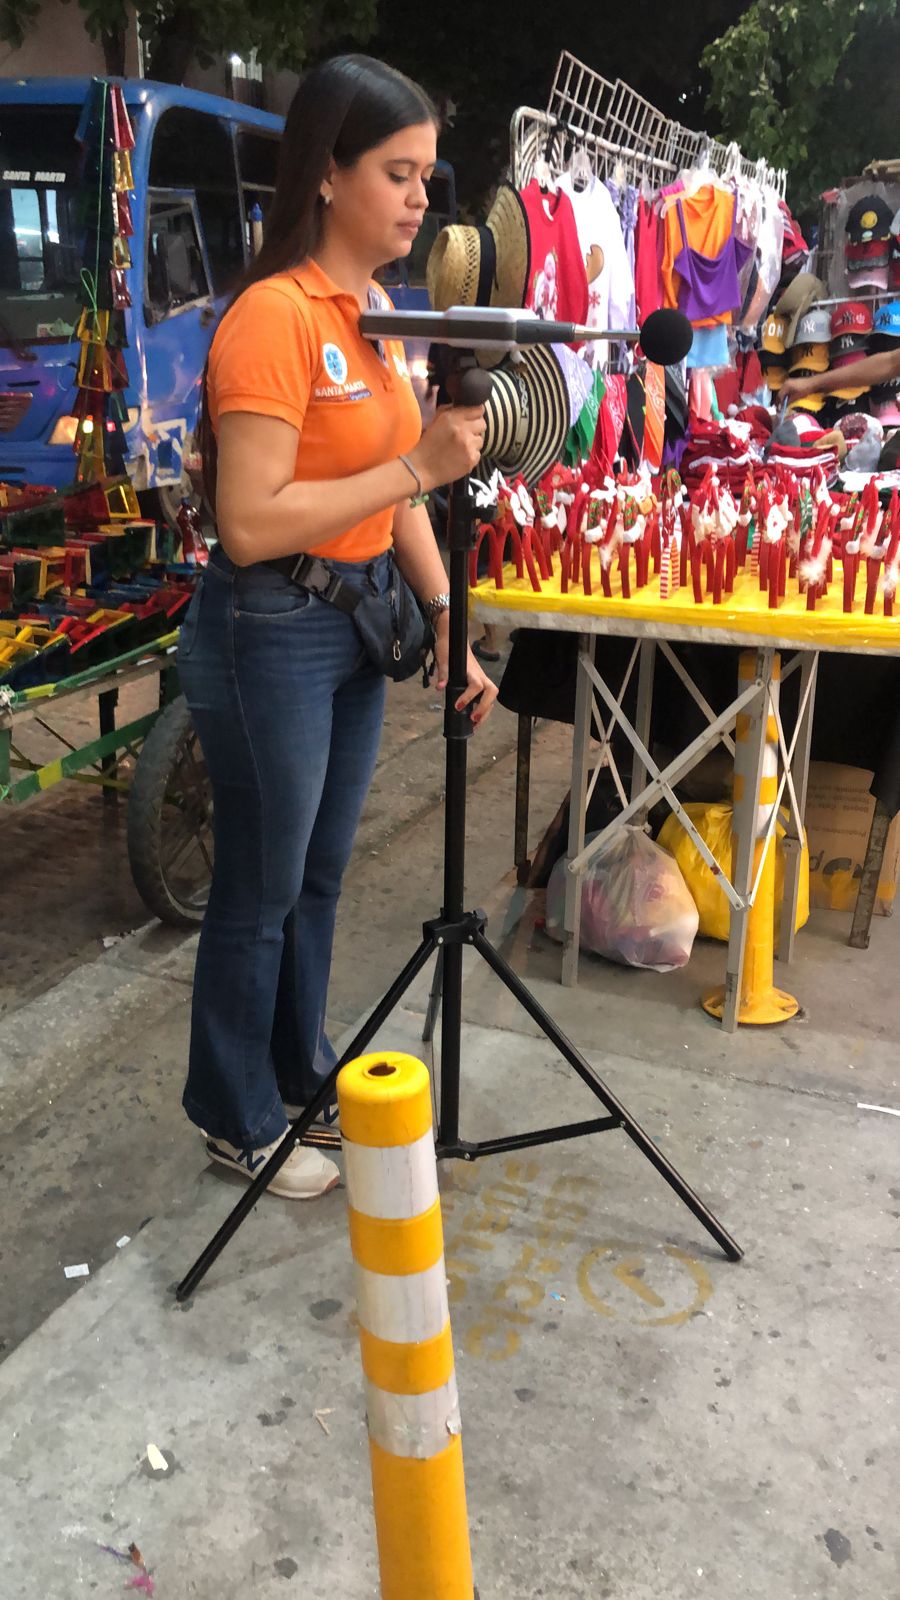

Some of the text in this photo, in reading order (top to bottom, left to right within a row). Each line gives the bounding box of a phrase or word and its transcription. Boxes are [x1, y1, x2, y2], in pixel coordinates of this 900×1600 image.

[2, 170, 66, 183] SANTA MARTA
[803, 319, 816, 335] NY
[315, 384, 343, 397] SANTA
